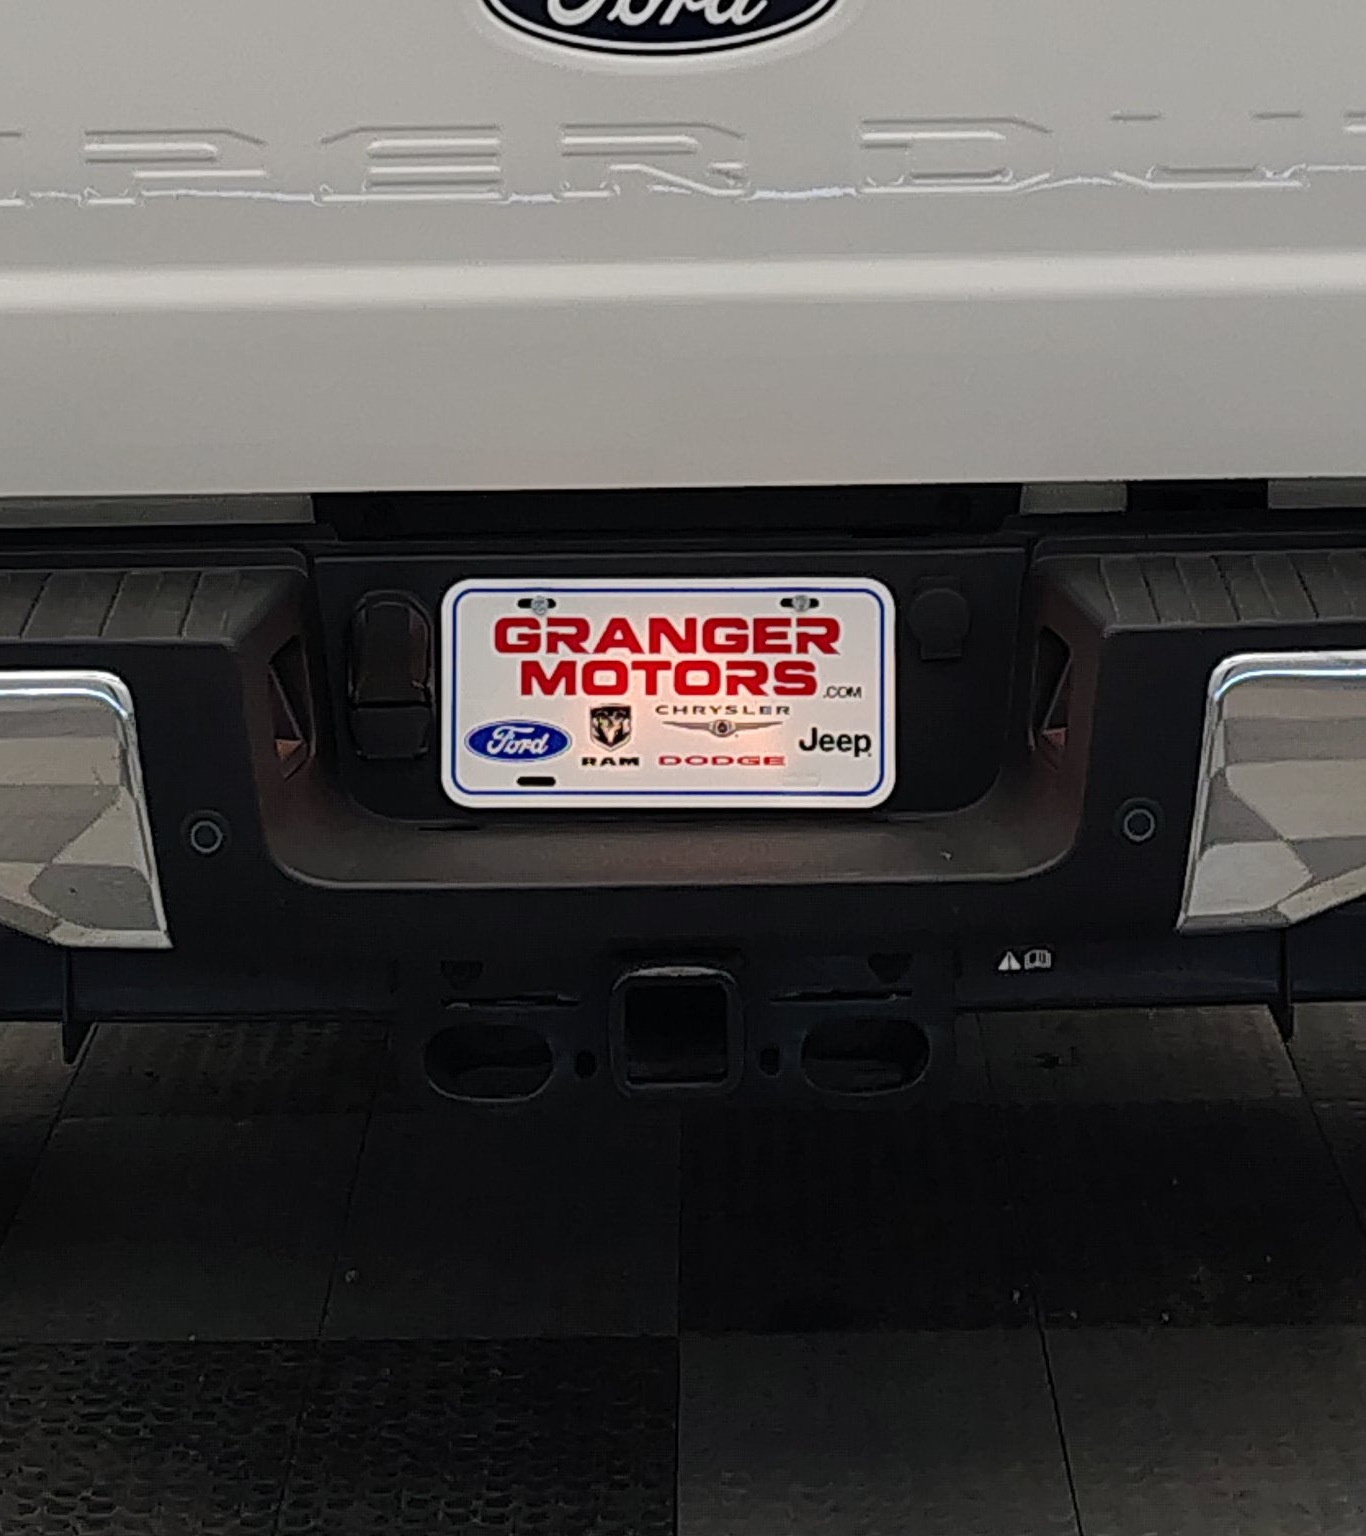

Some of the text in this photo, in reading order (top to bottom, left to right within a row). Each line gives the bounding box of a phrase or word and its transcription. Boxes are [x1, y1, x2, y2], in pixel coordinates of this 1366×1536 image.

[493, 616, 841, 655] GRANGER
[520, 660, 863, 700] MOTORS .COM
[655, 704, 791, 716] CHRYSLER
[486, 726, 550, 757] Ford
[798, 727, 873, 758] Jeep
[580, 755, 640, 768] RAM
[658, 755, 786, 767] DODGE
